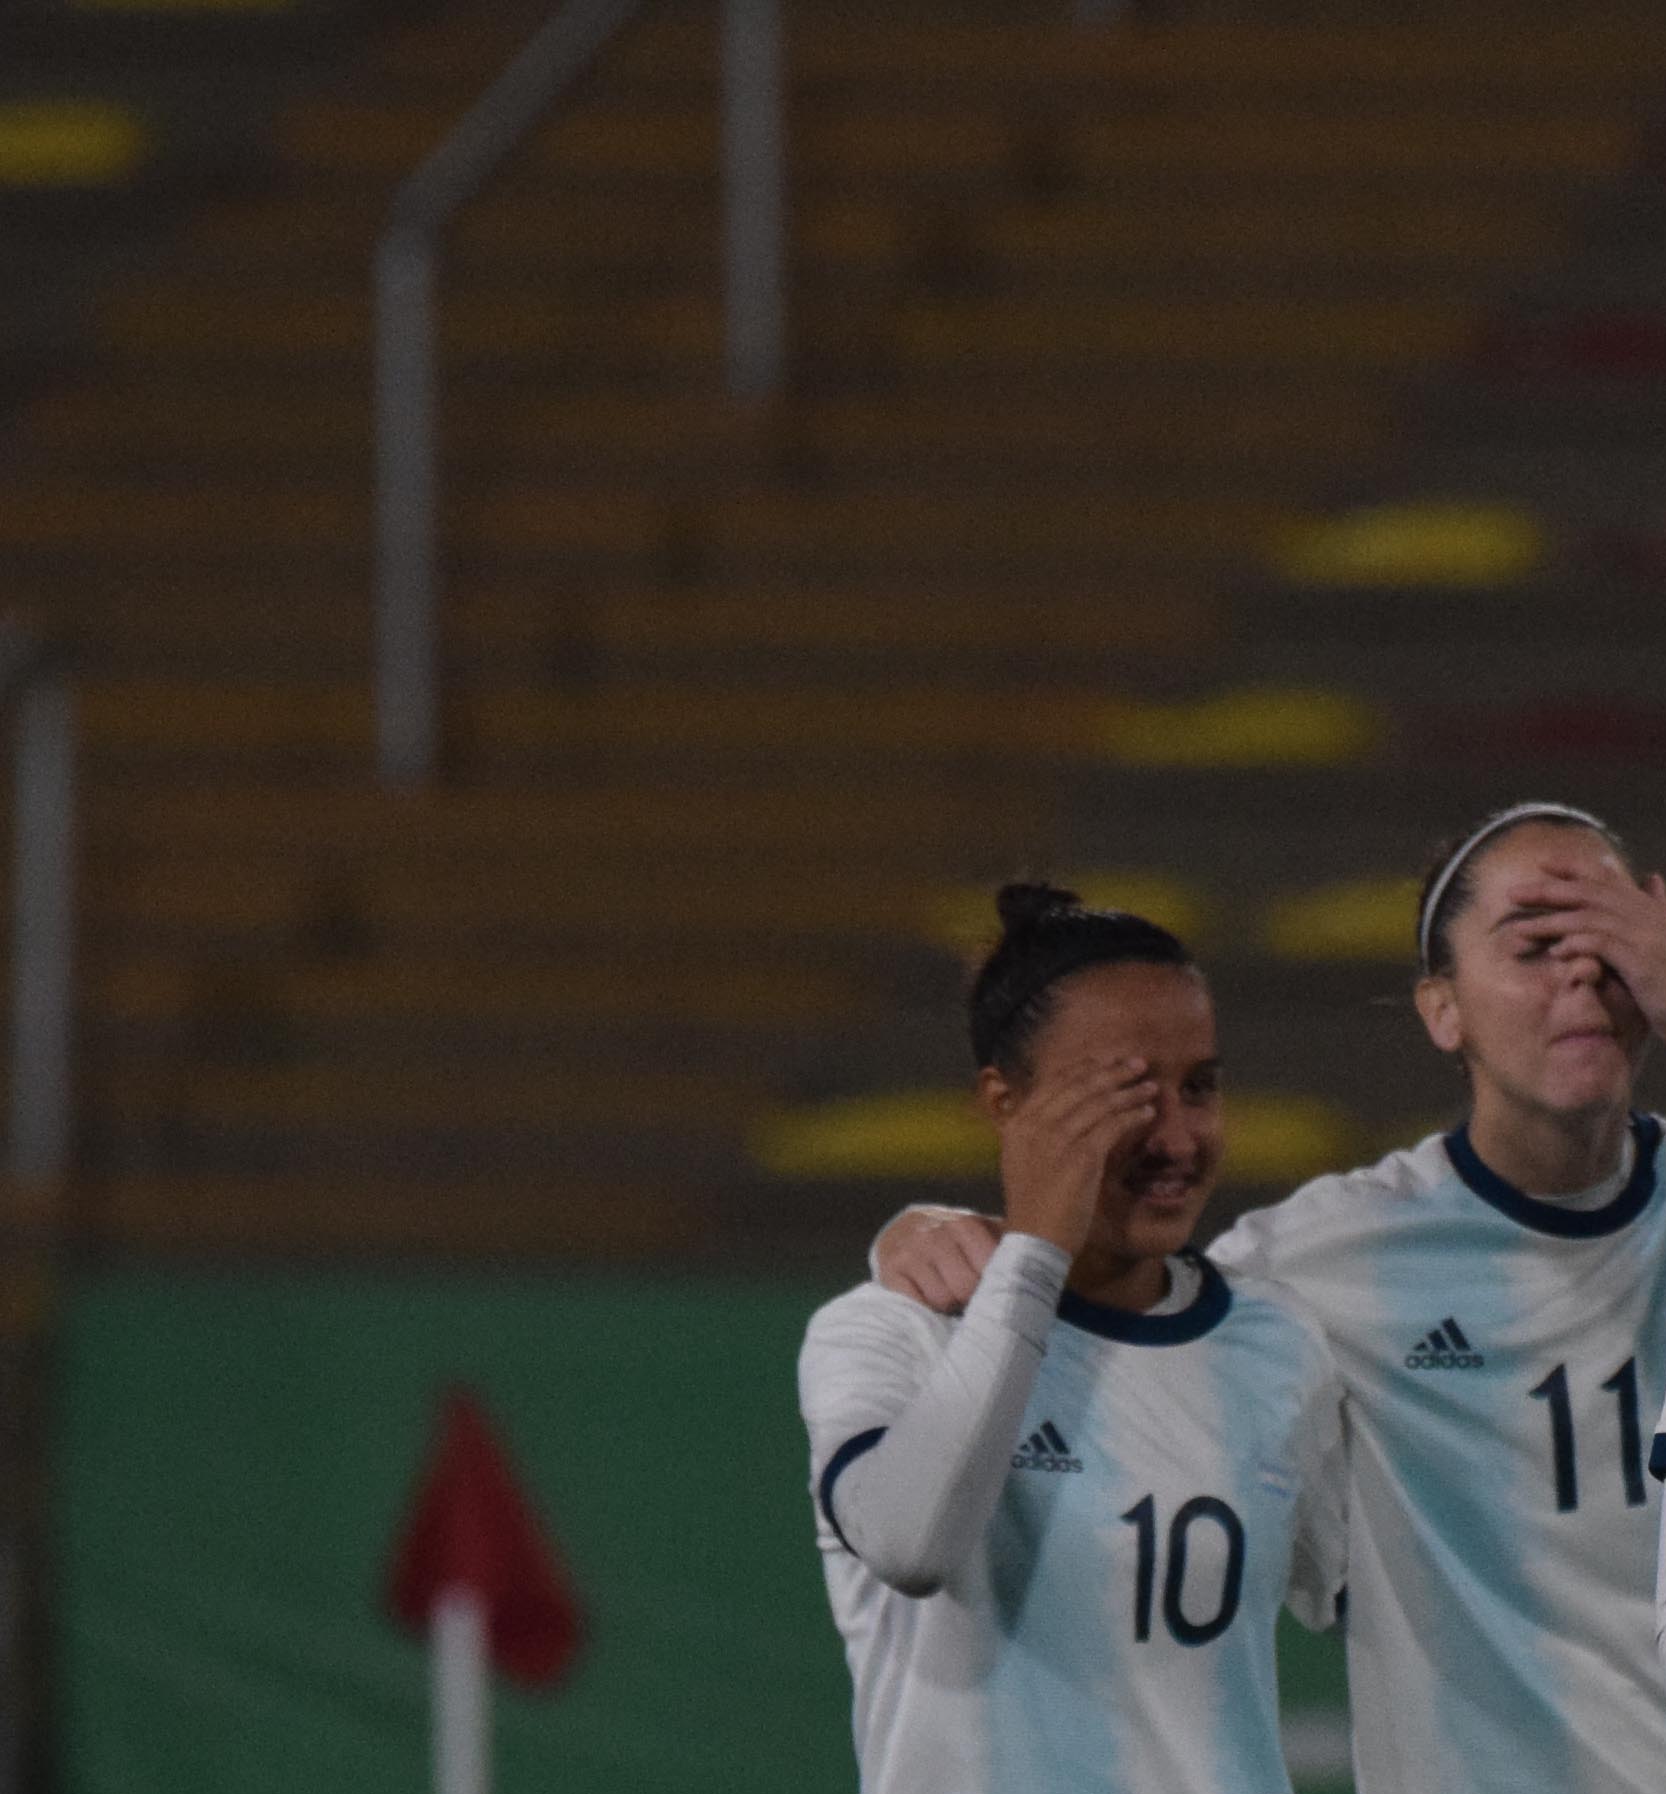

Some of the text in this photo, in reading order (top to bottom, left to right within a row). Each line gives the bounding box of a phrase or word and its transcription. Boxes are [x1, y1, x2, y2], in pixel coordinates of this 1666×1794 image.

[1405, 1351, 1485, 1370] adidas
[1529, 1355, 1647, 1513] 11
[1119, 1493, 1245, 1648] 10
